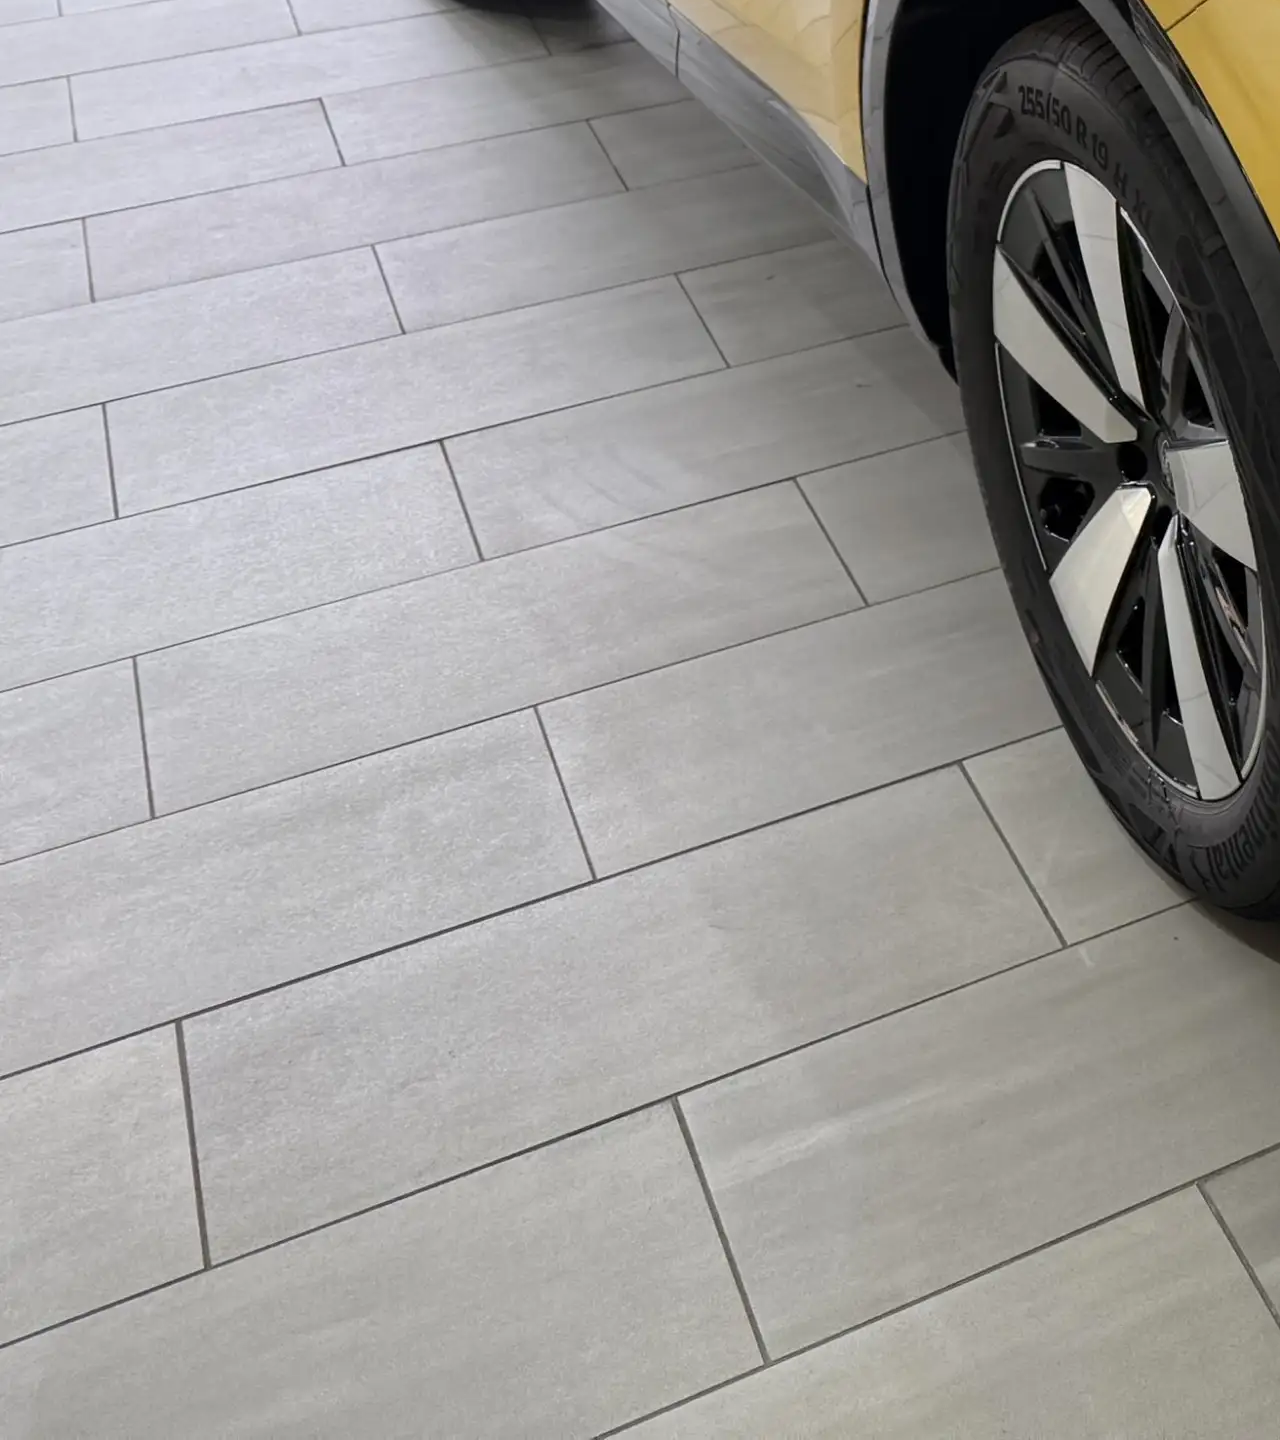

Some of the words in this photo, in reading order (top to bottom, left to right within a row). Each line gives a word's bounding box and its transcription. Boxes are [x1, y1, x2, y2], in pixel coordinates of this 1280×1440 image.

[1018, 84, 1072, 136] 255/50
[1076, 115, 1088, 150] R
[1092, 133, 1109, 172] 19
